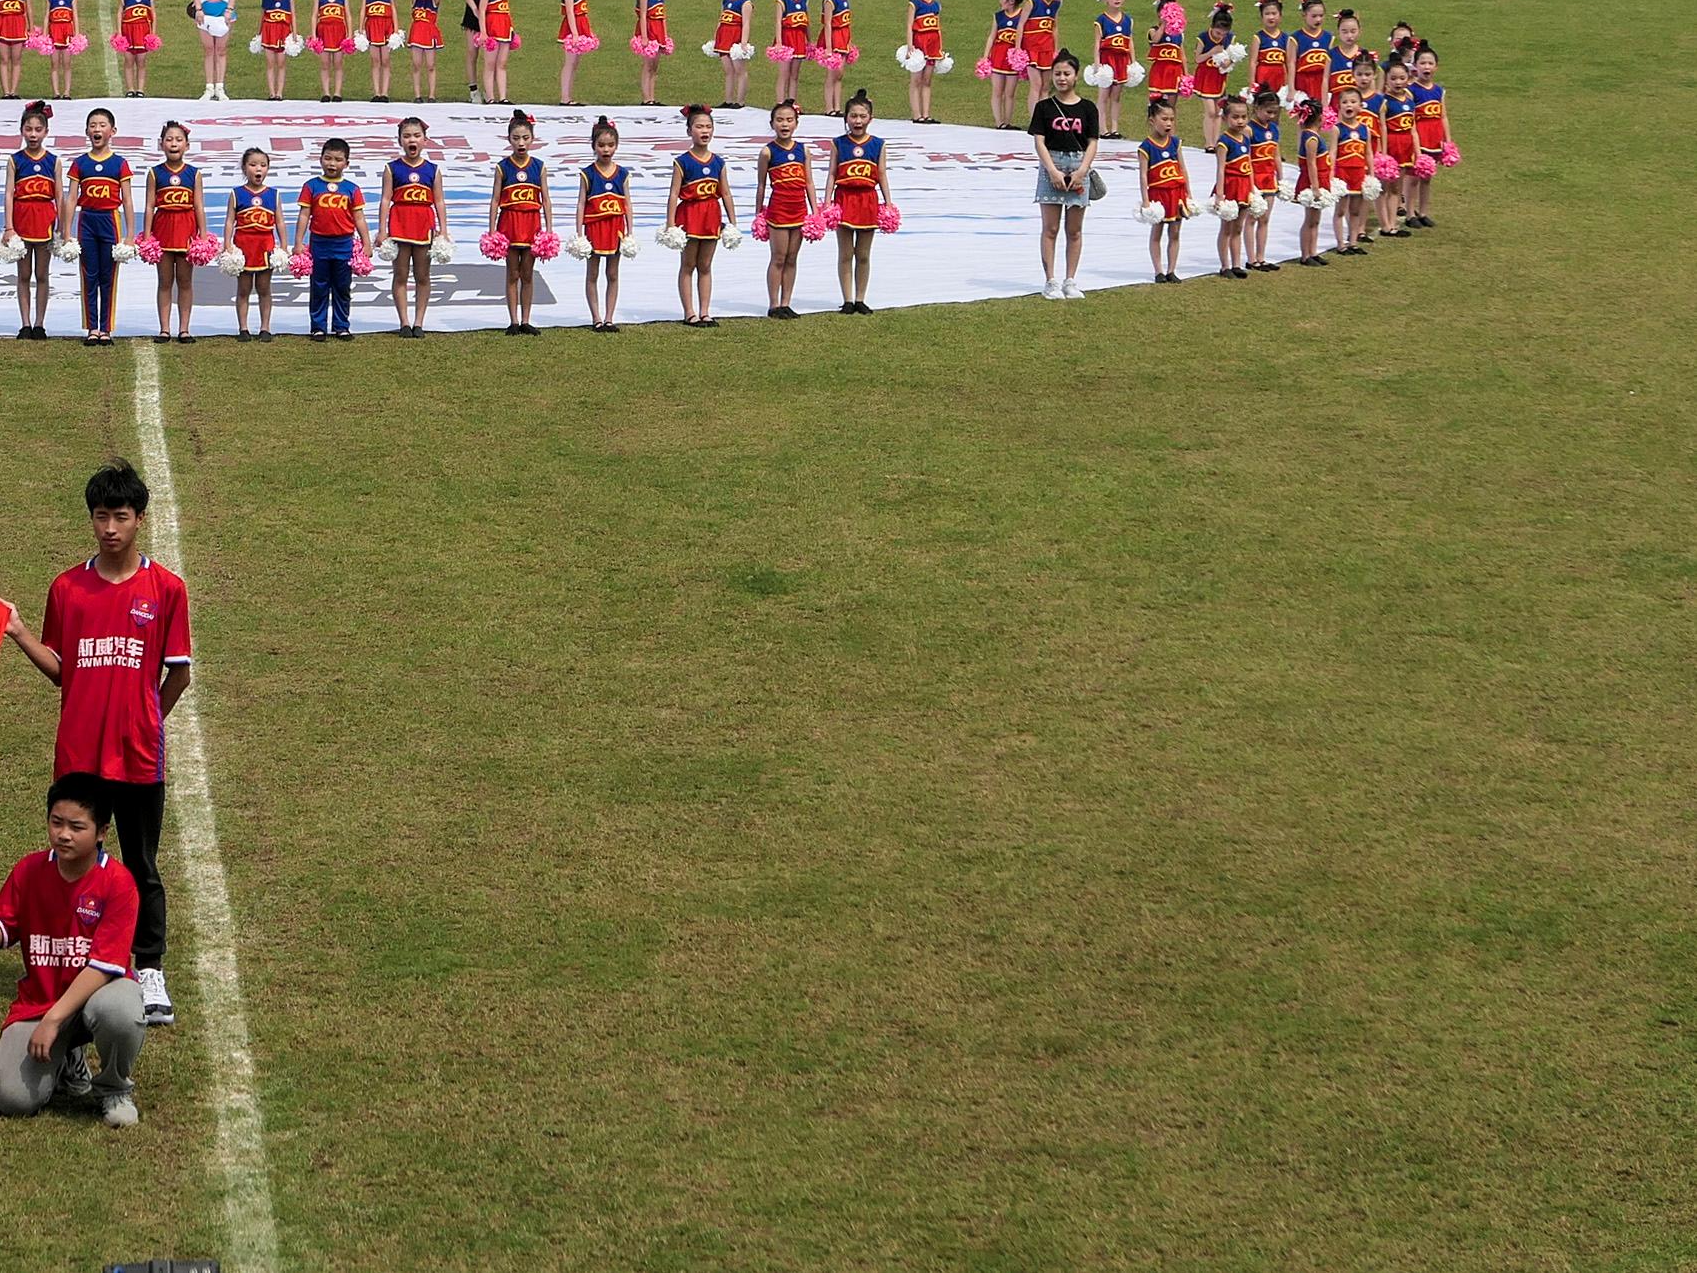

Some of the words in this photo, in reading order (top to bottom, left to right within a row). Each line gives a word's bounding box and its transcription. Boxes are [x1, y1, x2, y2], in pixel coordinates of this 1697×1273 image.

[3, 2, 21, 11] CCA
[323, 7, 341, 15] CCA
[368, 5, 386, 15] CCA
[52, 10, 70, 19] CCA
[270, 13, 287, 22] CCA
[791, 13, 808, 24] CCA
[1159, 49, 1178, 60] CCA
[1266, 51, 1285, 62] CCA
[1052, 116, 1082, 134] CCA
[1344, 142, 1365, 155] CCA
[781, 165, 804, 177] CCA
[847, 164, 871, 177] CCA
[24, 180, 50, 193] CCA
[86, 185, 111, 199] CCA
[697, 182, 717, 195] CCA
[164, 191, 189, 203] CCA
[318, 194, 348, 208] CCA
[404, 189, 427, 201] CCA
[511, 189, 535, 201] CCA
[599, 199, 621, 211] CCA
[243, 211, 268, 223] CCA
[78, 637, 144, 657] 斯威汽车
[77, 656, 102, 668] SWM
[30, 956, 59, 967] SWM
